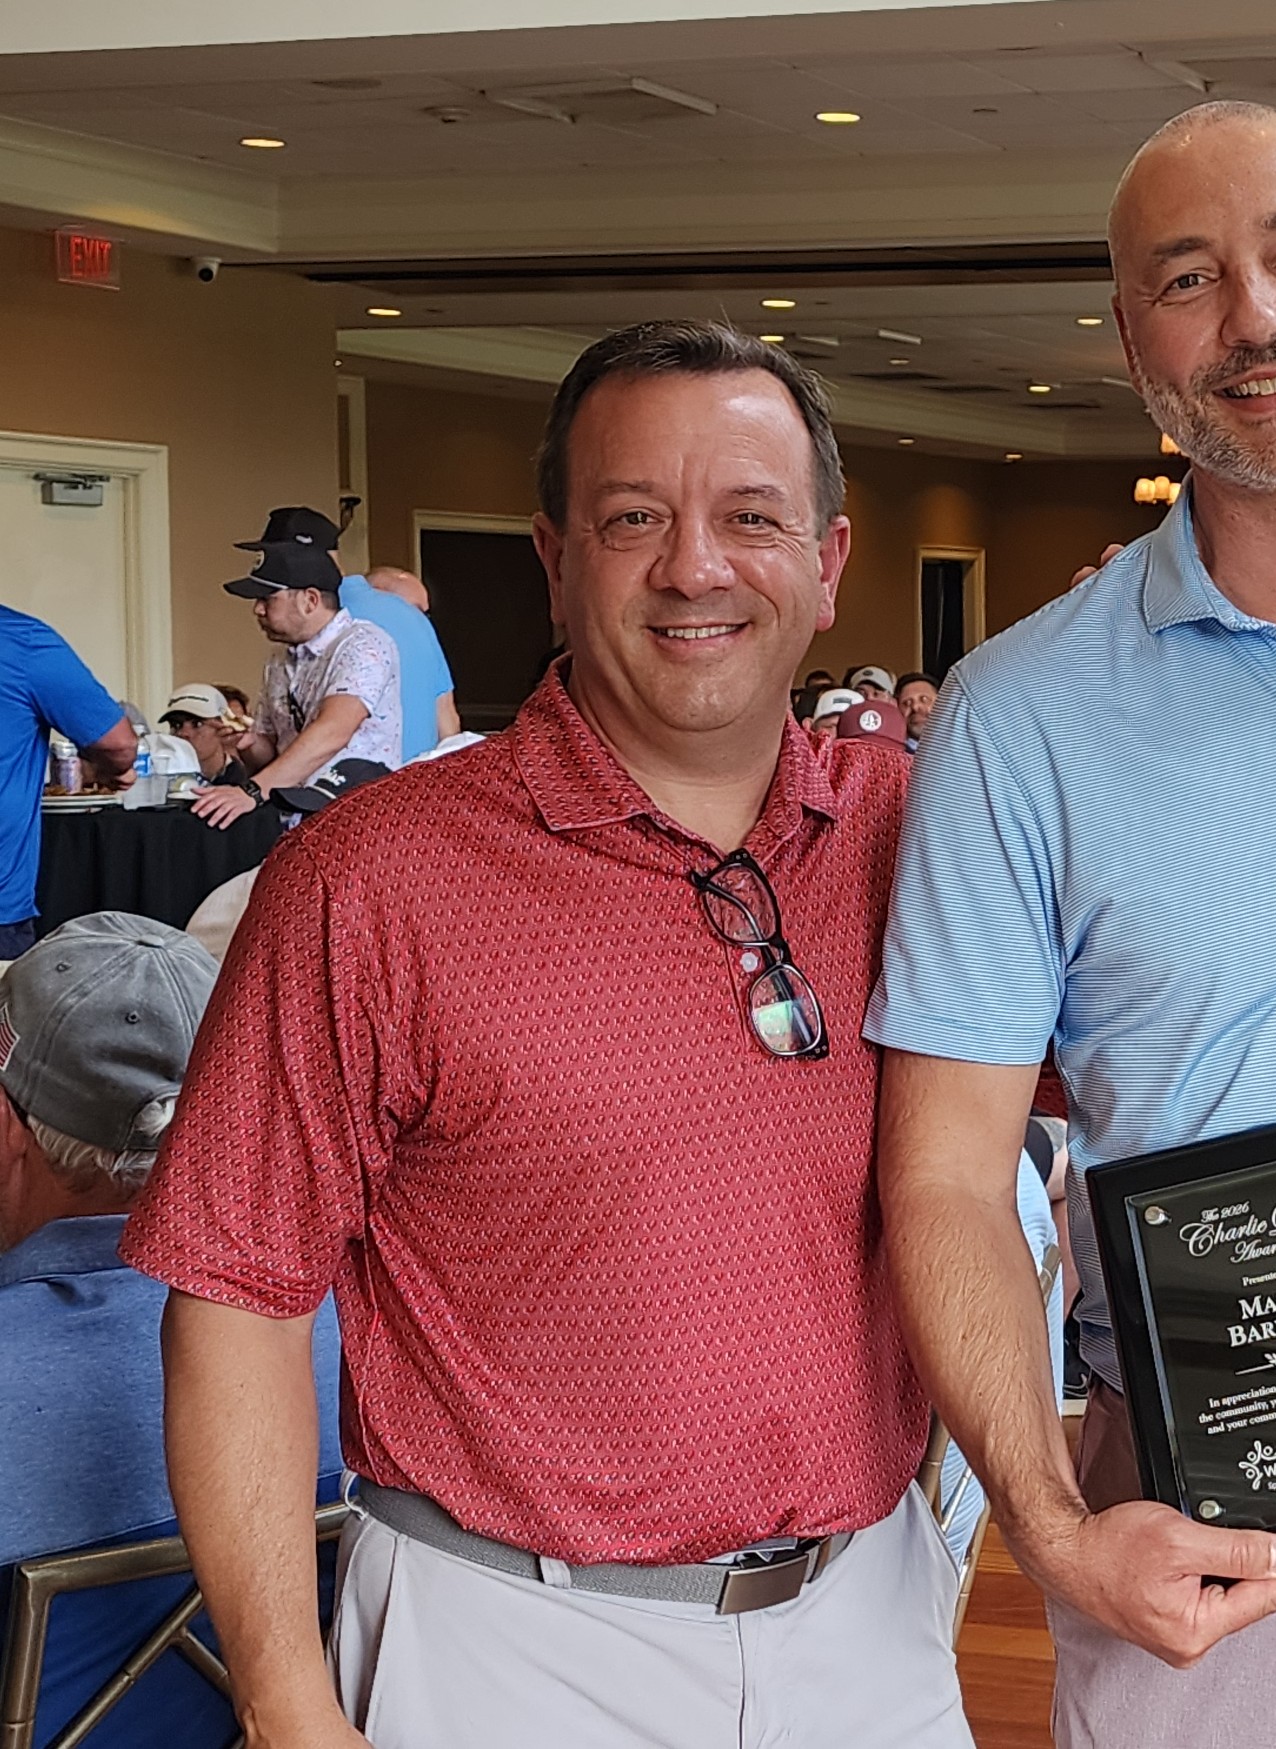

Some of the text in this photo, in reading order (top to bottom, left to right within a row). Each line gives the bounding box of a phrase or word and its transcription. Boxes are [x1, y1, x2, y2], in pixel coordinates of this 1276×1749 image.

[70, 234, 112, 278] EXIT
[1220, 1201, 1250, 1219] 2026
[1179, 1214, 1268, 1257] Charlie
[1198, 1413, 1214, 1424] the
[1215, 1401, 1269, 1420] community,
[1208, 1398, 1221, 1408] In
[1207, 1422, 1226, 1435] and
[1226, 1419, 1248, 1432] your
